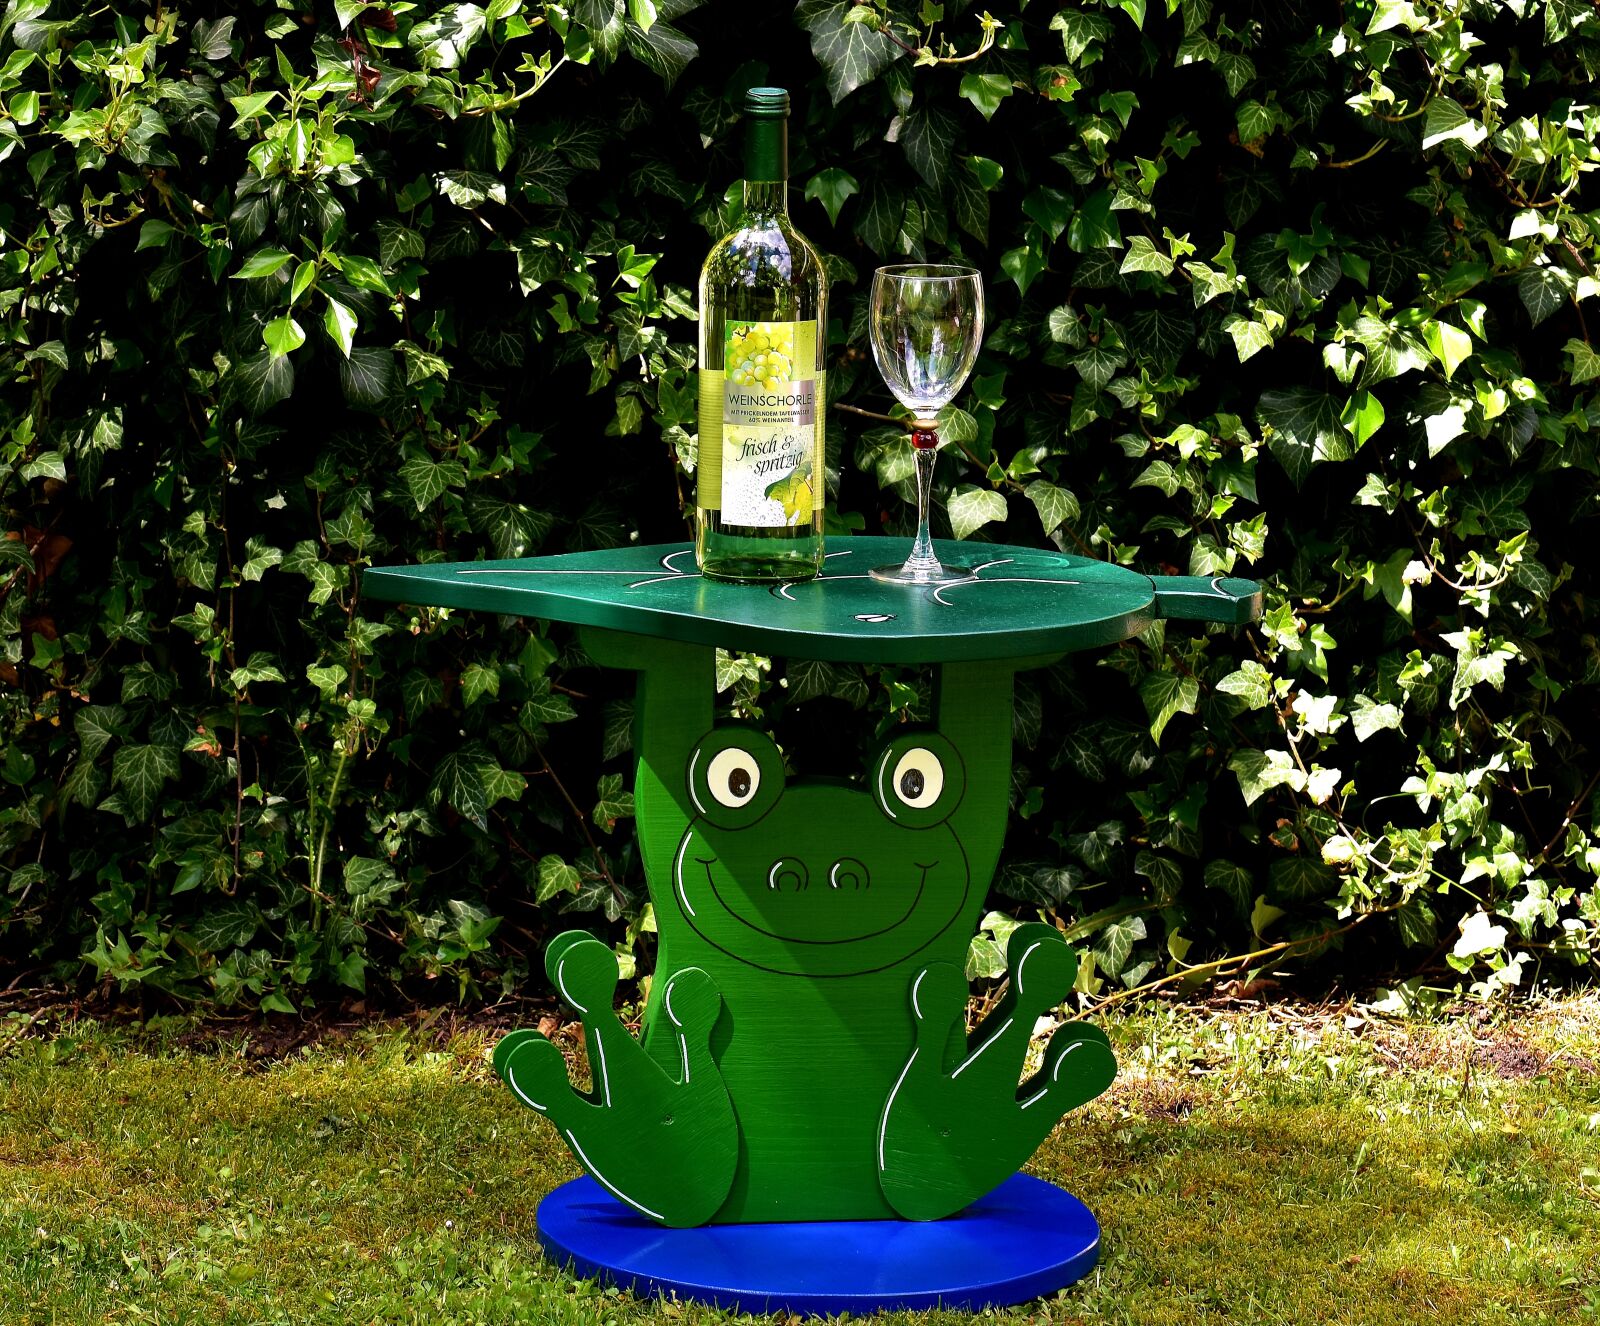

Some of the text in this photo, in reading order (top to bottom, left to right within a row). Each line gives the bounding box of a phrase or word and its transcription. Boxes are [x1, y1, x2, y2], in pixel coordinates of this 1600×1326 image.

[728, 393, 812, 407] WEINSCHORLE
[736, 434, 795, 462] frisch &
[753, 449, 804, 477] spritzig
